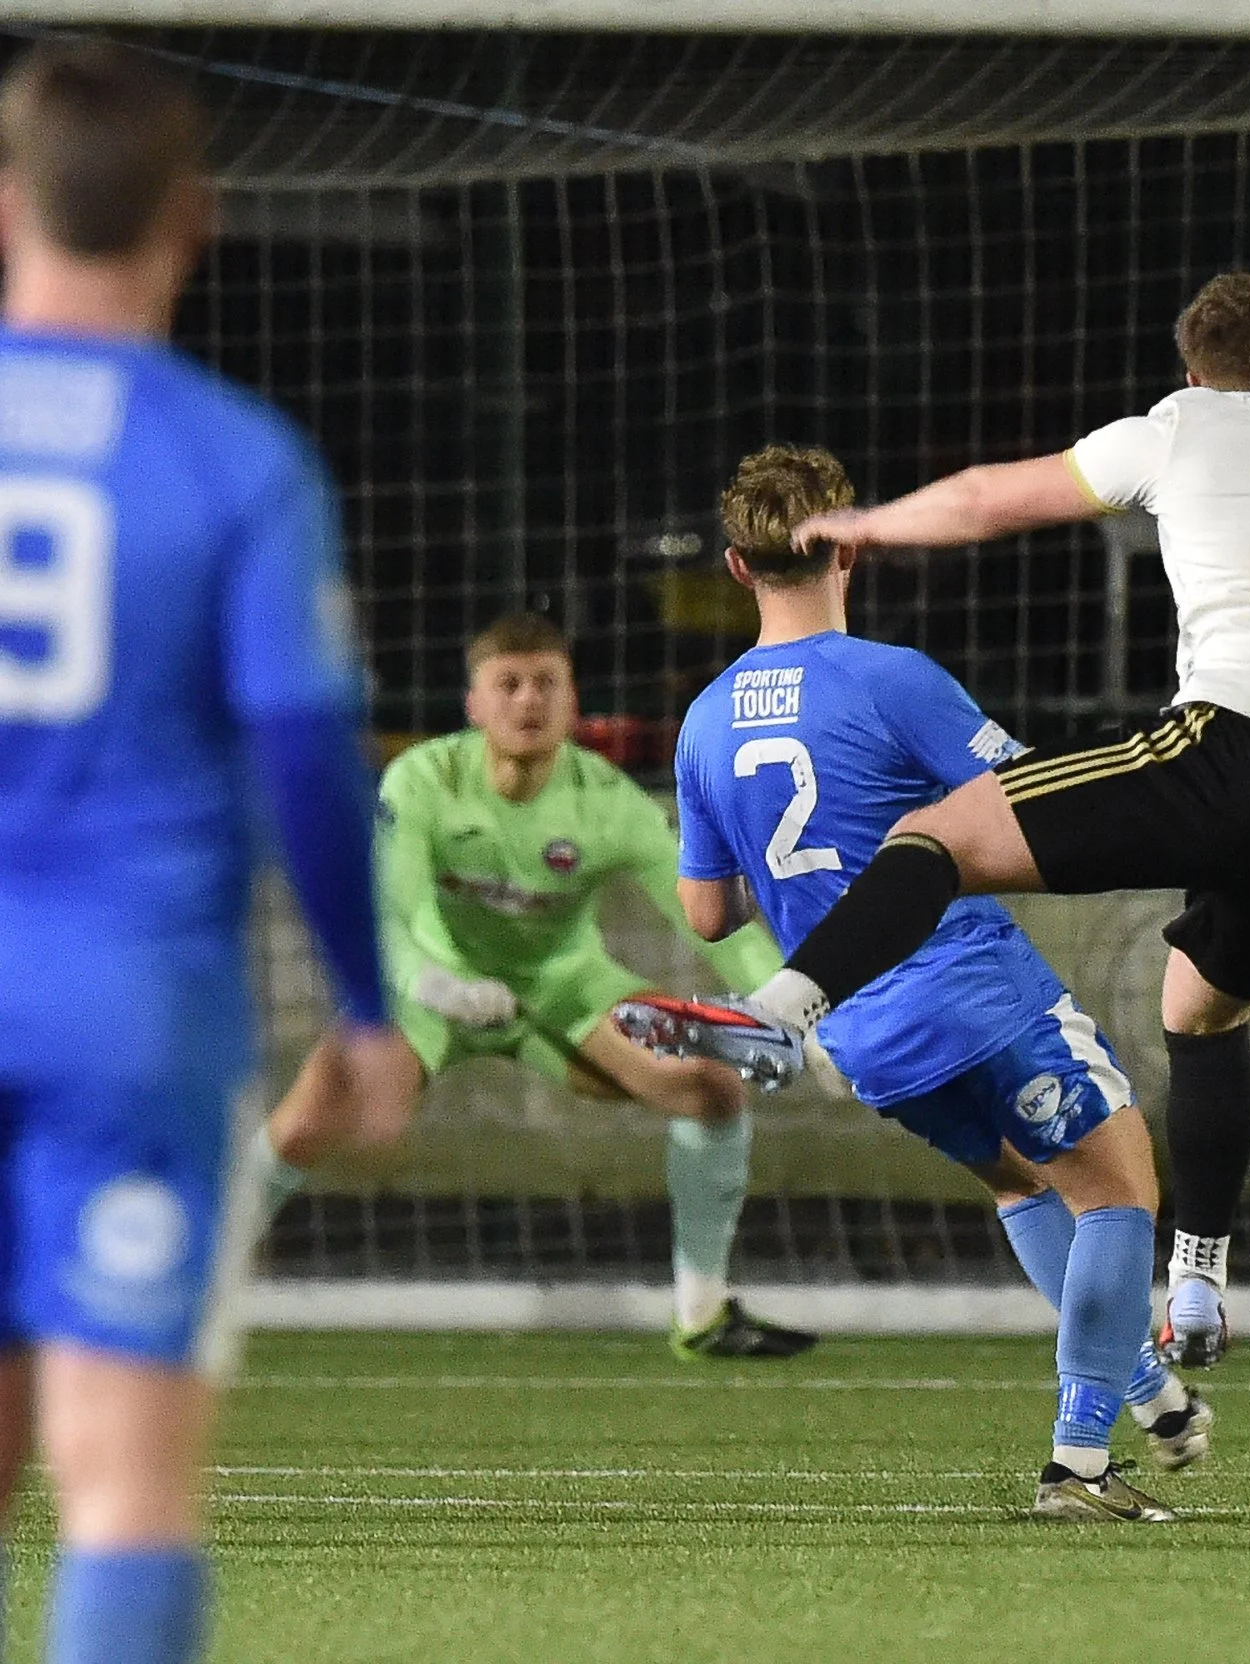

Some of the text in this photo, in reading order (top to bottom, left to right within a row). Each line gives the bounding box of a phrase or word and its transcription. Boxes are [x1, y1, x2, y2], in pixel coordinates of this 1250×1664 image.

[0, 476, 114, 727] 9
[732, 686, 800, 720] TOUCH
[733, 667, 803, 689] SPORTING
[734, 738, 842, 880] 2
